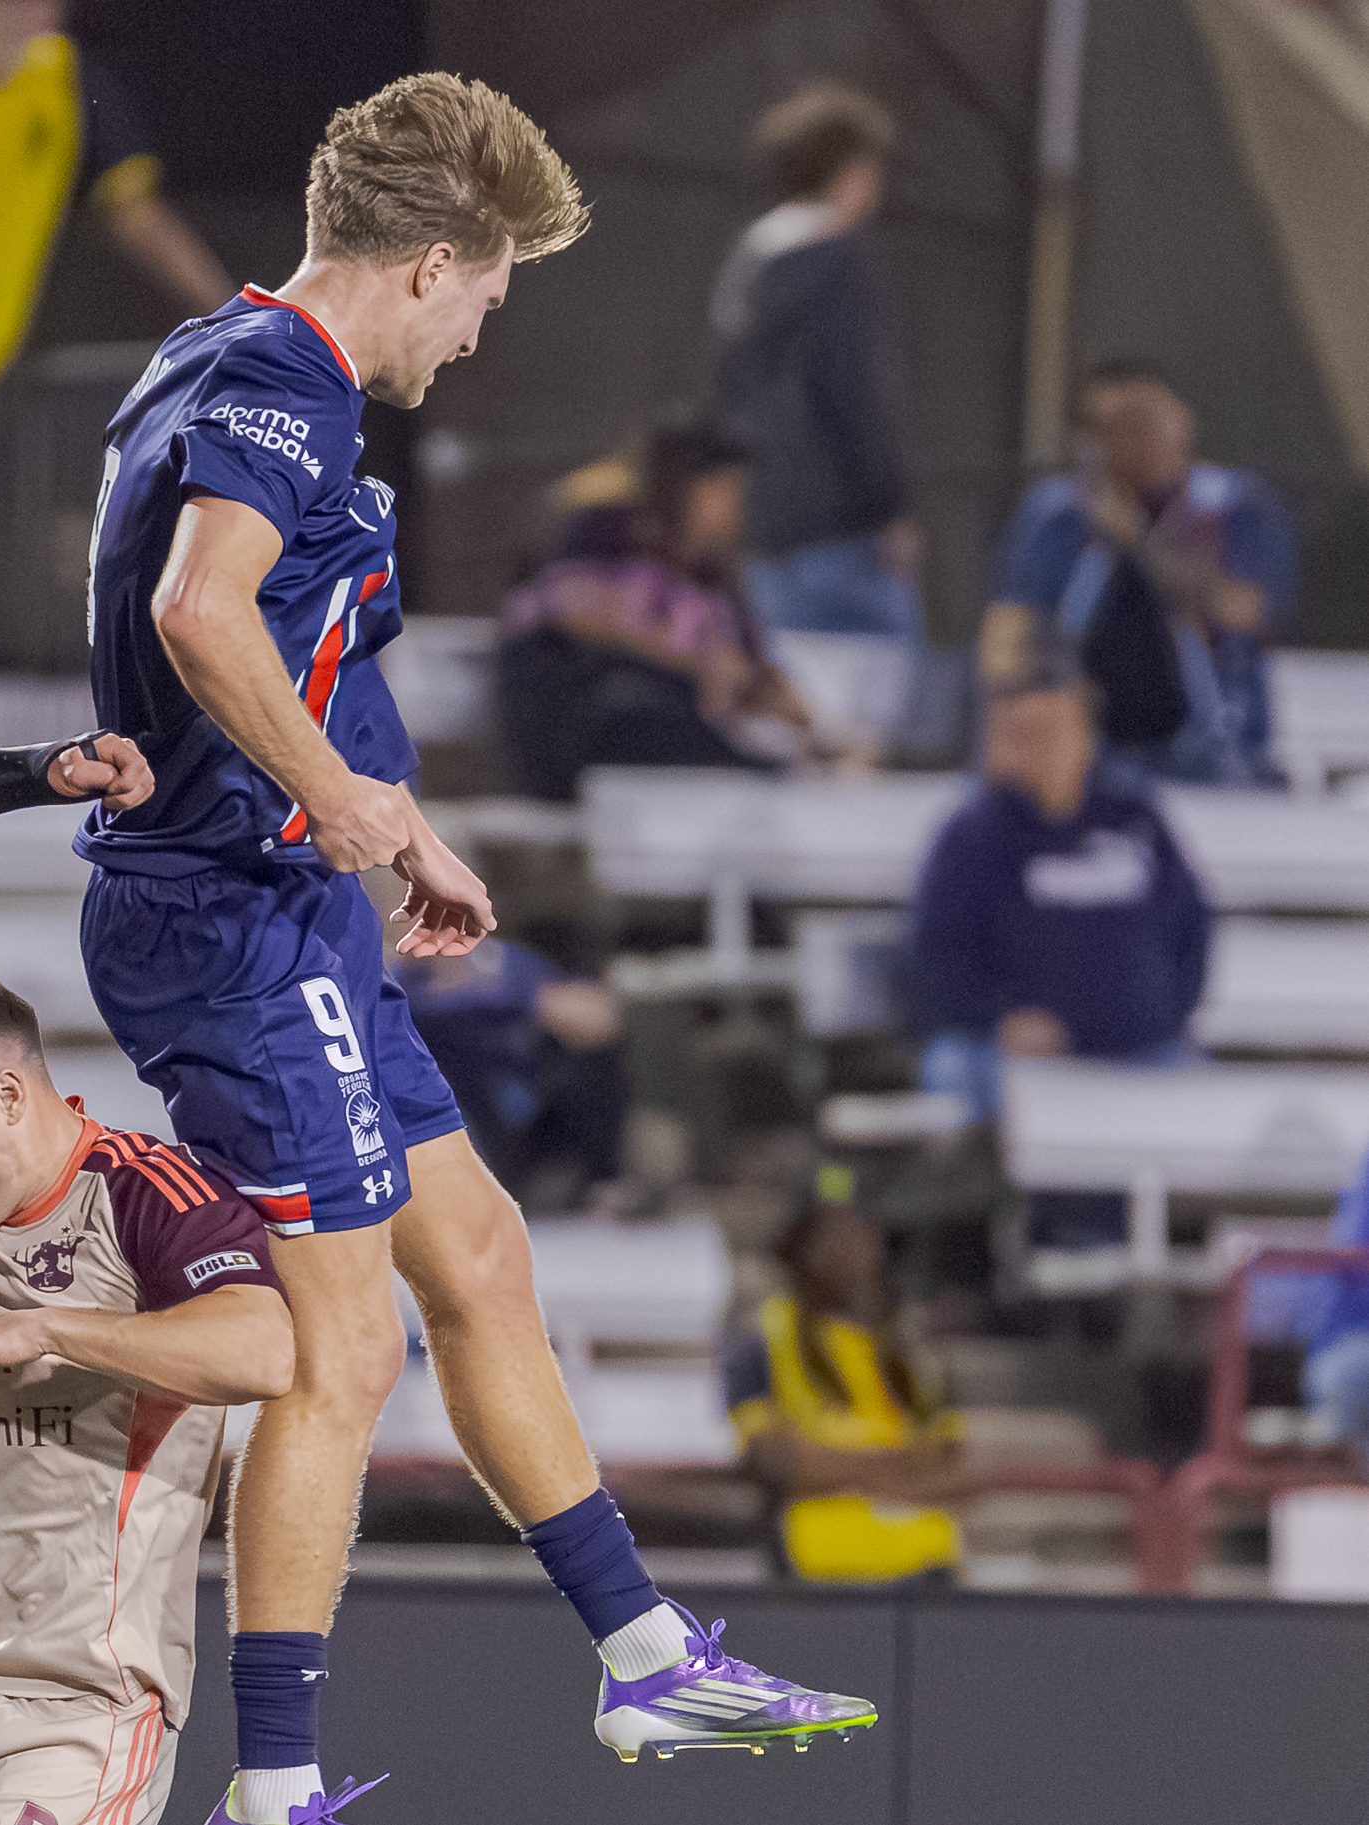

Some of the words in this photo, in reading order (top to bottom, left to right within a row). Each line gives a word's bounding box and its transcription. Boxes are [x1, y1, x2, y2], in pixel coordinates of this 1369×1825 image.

[209, 402, 311, 441] dorma
[229, 417, 299, 461] kaba
[299, 976, 366, 1073] 9
